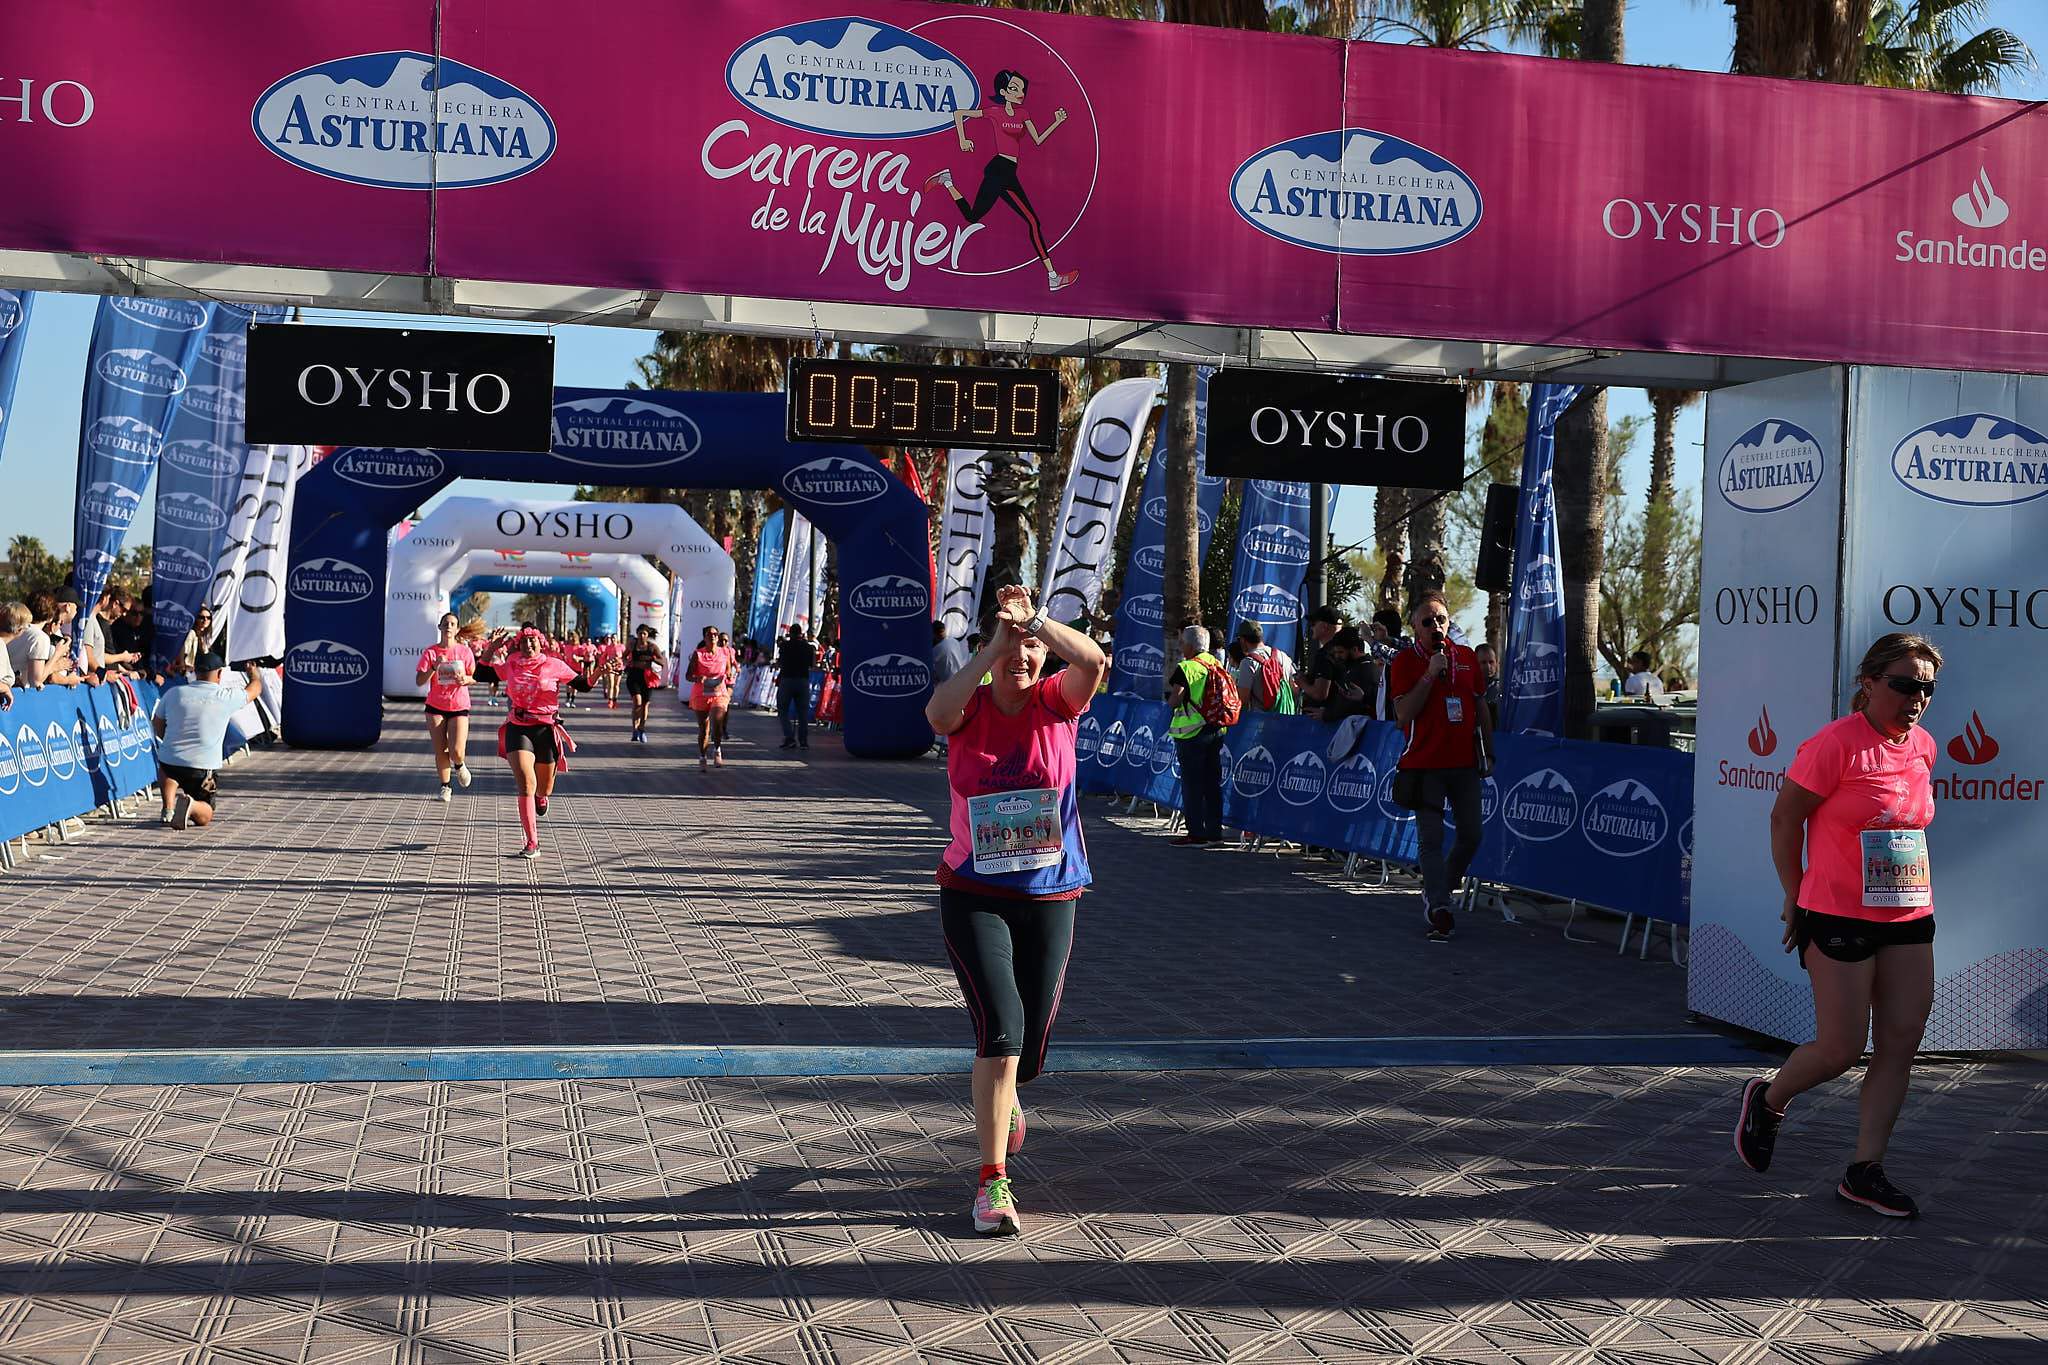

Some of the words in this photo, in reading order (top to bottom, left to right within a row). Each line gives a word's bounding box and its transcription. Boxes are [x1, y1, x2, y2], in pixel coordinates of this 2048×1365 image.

[786, 53, 865, 71] CENTRAL
[873, 61, 954, 79] LECHERA
[745, 52, 959, 115] ASTURIANA
[325, 93, 420, 112] CENTRAL
[275, 94, 534, 160] ASTURIANA
[701, 119, 910, 195] Carrera
[1290, 168, 1369, 184] CENTRAL
[1376, 174, 1456, 191] LECHERA
[1249, 168, 1463, 227] ASTURIANA
[1602, 197, 1787, 250] OYSHO
[750, 189, 791, 232] de
[798, 190, 827, 236] la
[818, 190, 986, 292] Mujer
[1895, 230, 2048, 272] Santande
[297, 363, 511, 415] OYSHO
[568, 415, 624, 427] CENTRAL
[628, 418, 684, 429] LECHERA
[1250, 405, 1430, 454] OYSHO
[1739, 450, 1774, 465] CENTRAL
[1775, 445, 1813, 459] LECHERA
[1931, 443, 1988, 456] CENTRAL
[1992, 446, 2048, 459] LECHERA
[340, 455, 436, 478] ASTURIANA
[1724, 458, 1816, 493] ASTURIANA
[1903, 445, 2048, 485] ASTURIANA
[792, 475, 882, 493] ASTURIANA
[496, 509, 633, 541] OYSHO
[412, 537, 455, 547] OYSHO
[671, 543, 712, 554] OYSHO
[292, 574, 368, 594] ASTURIANA
[391, 591, 432, 601] OYSHO
[690, 600, 728, 609] OYSHO
[855, 591, 926, 608] ASTURIANA
[1714, 584, 1819, 626] OYSHO
[288, 655, 363, 675] ASTURIANA
[856, 670, 928, 687] ASTURIANA
[1279, 769, 1322, 793] ASTURIANA
[1329, 774, 1373, 799] ASTURIANA
[1718, 760, 1788, 793] Santand
[1930, 773, 2046, 802] ntander
[1506, 792, 1571, 826] ASTURIANA
[1000, 825, 1034, 841] 016
[1586, 802, 1657, 842] ASTURIANA
[1891, 864, 1918, 877] 016
